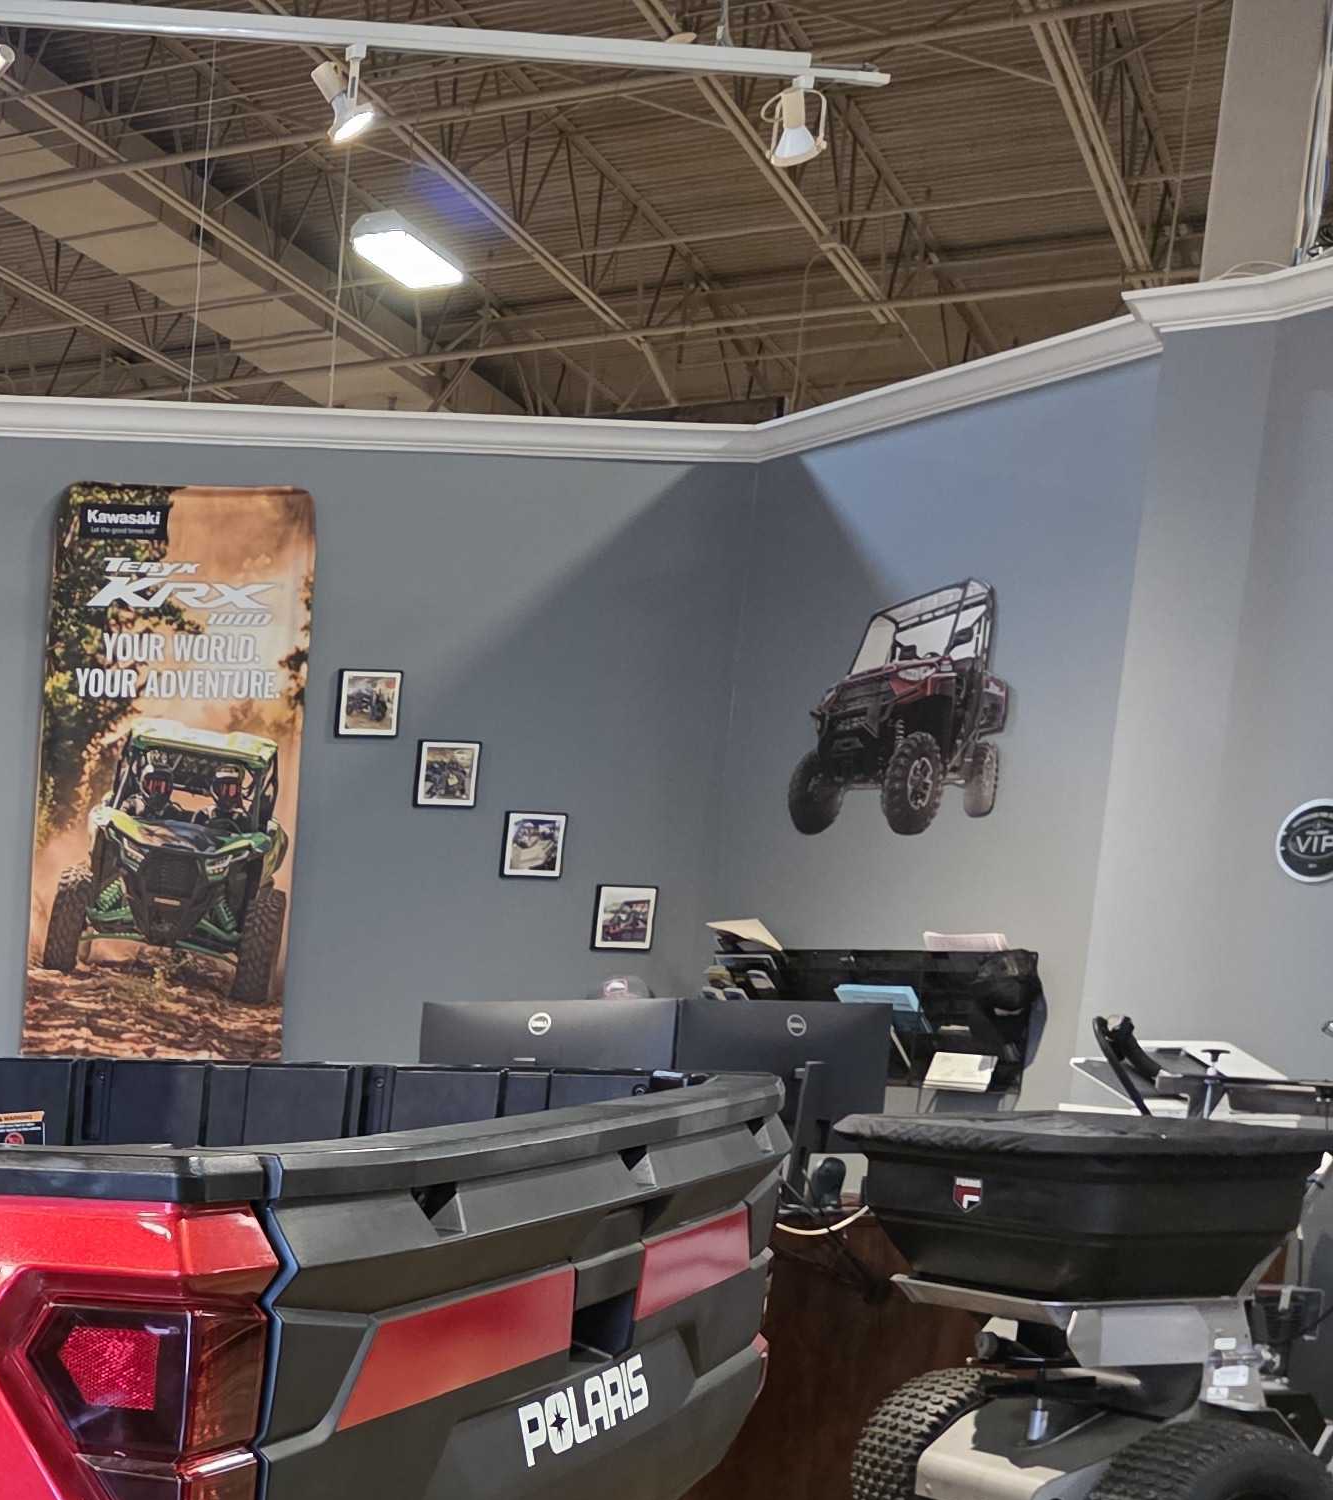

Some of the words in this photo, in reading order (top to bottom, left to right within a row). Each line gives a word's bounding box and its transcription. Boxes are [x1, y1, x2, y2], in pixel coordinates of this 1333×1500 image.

[86, 509, 161, 525] Kawasaki
[86, 576, 276, 609] KRX
[208, 612, 274, 627] 1000
[103, 632, 165, 662] YOUR
[174, 634, 261, 664] WORLD.
[75, 667, 137, 698] YOUR
[145, 669, 281, 699] ADVENTURE.
[1296, 835, 1333, 853] VIP
[518, 1353, 649, 1468] POLARIS
